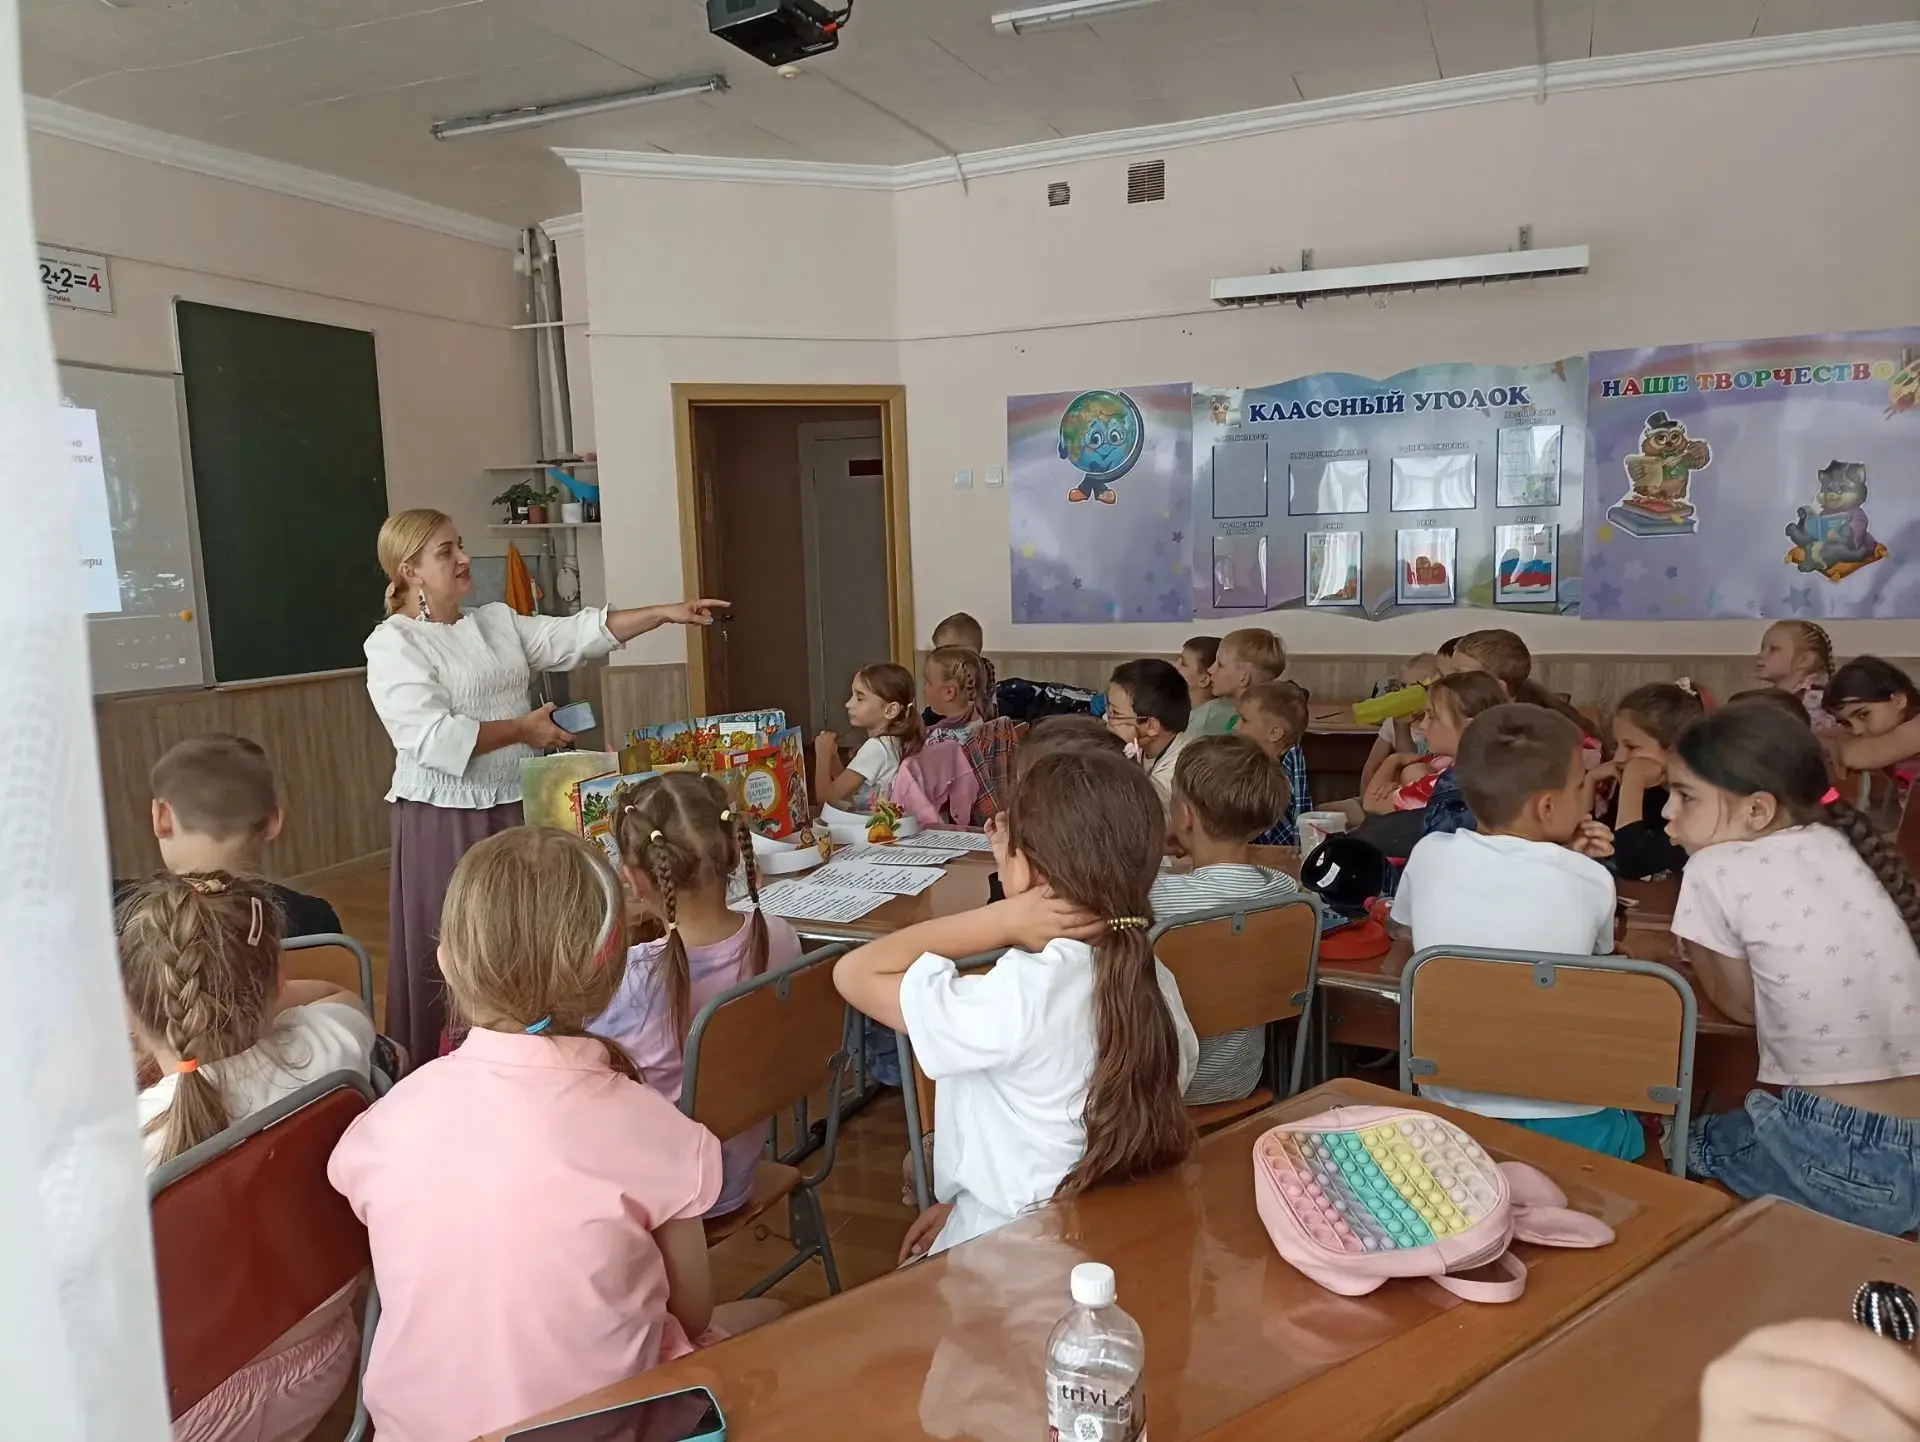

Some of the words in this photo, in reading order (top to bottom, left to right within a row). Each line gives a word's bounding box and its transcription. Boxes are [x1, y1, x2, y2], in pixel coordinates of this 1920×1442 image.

[39, 264, 102, 293] 2+2=4
[48, 294, 71, 303] СУММА
[1601, 375, 1688, 398] НАШЕ
[1697, 360, 1895, 391] ТВОРЧЕСТВО
[1249, 391, 1405, 422] КЛАССНЫЙ
[1412, 386, 1531, 411] УГОЛОК
